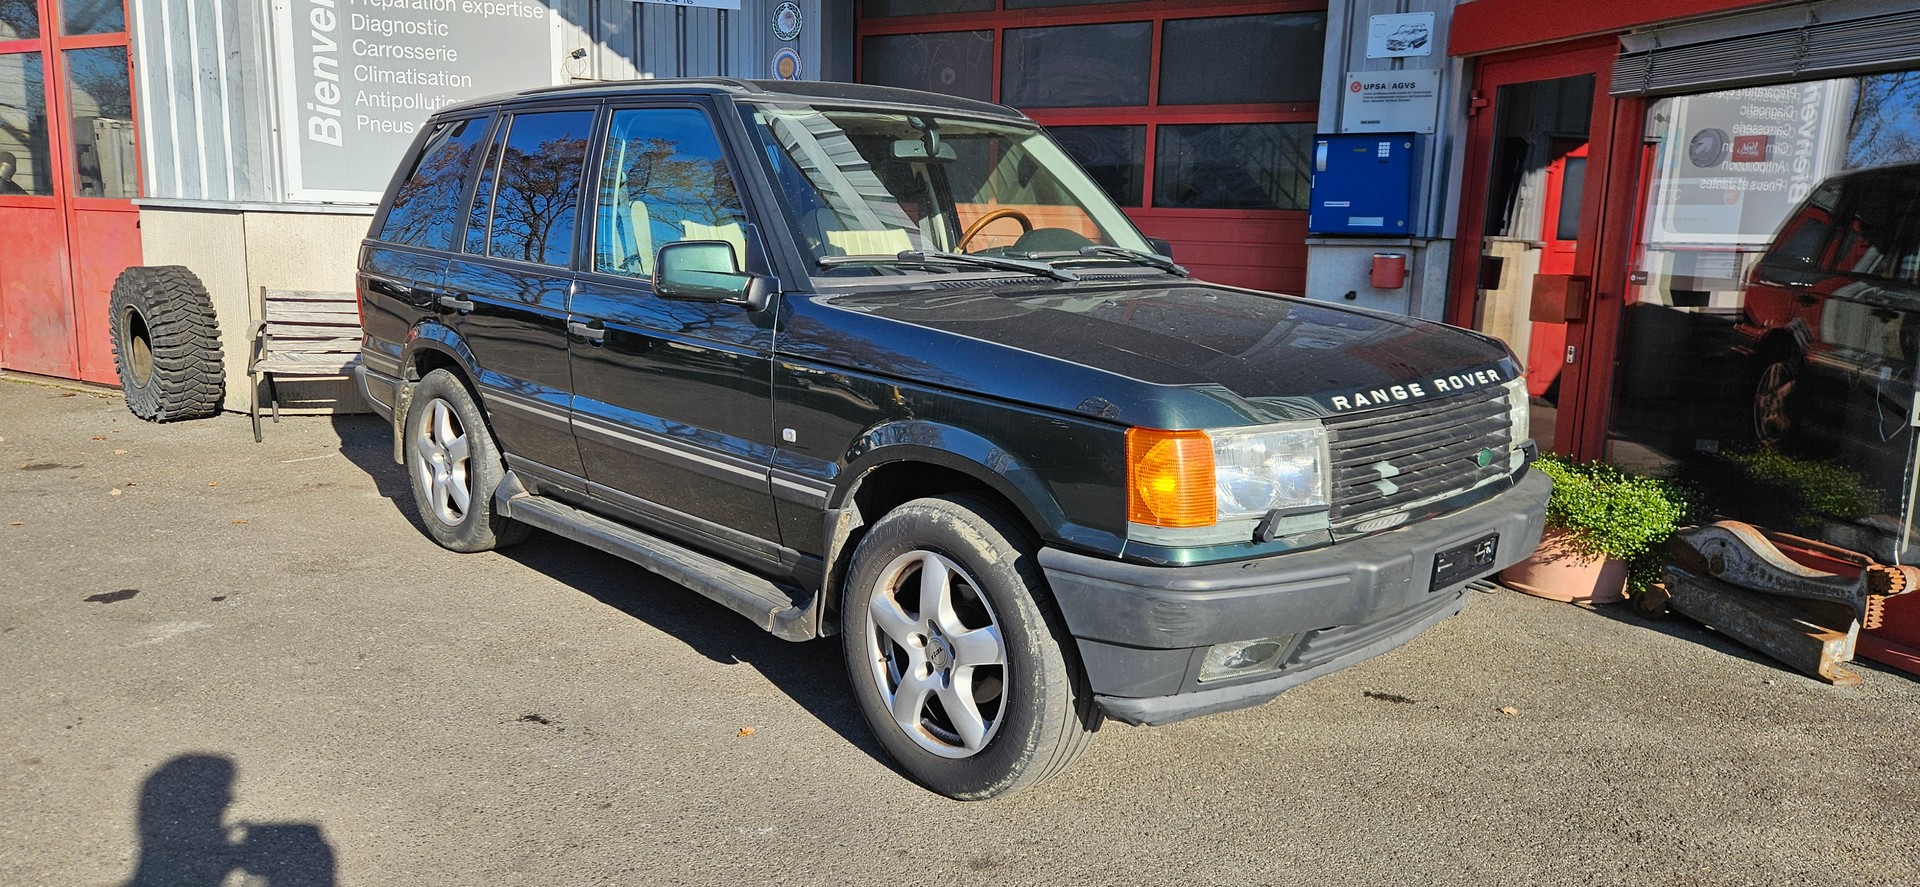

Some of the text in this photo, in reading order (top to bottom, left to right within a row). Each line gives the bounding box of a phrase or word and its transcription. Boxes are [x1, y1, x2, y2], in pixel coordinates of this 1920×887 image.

[462, 0, 544, 18] expertise
[351, 13, 449, 37] Diagnostic
[352, 39, 458, 62] Carrosserie
[353, 65, 472, 88] Climatisation
[355, 89, 465, 112] Antipolluti
[356, 114, 414, 134] Pneus
[1331, 369, 1501, 411] RANGE ROVER
